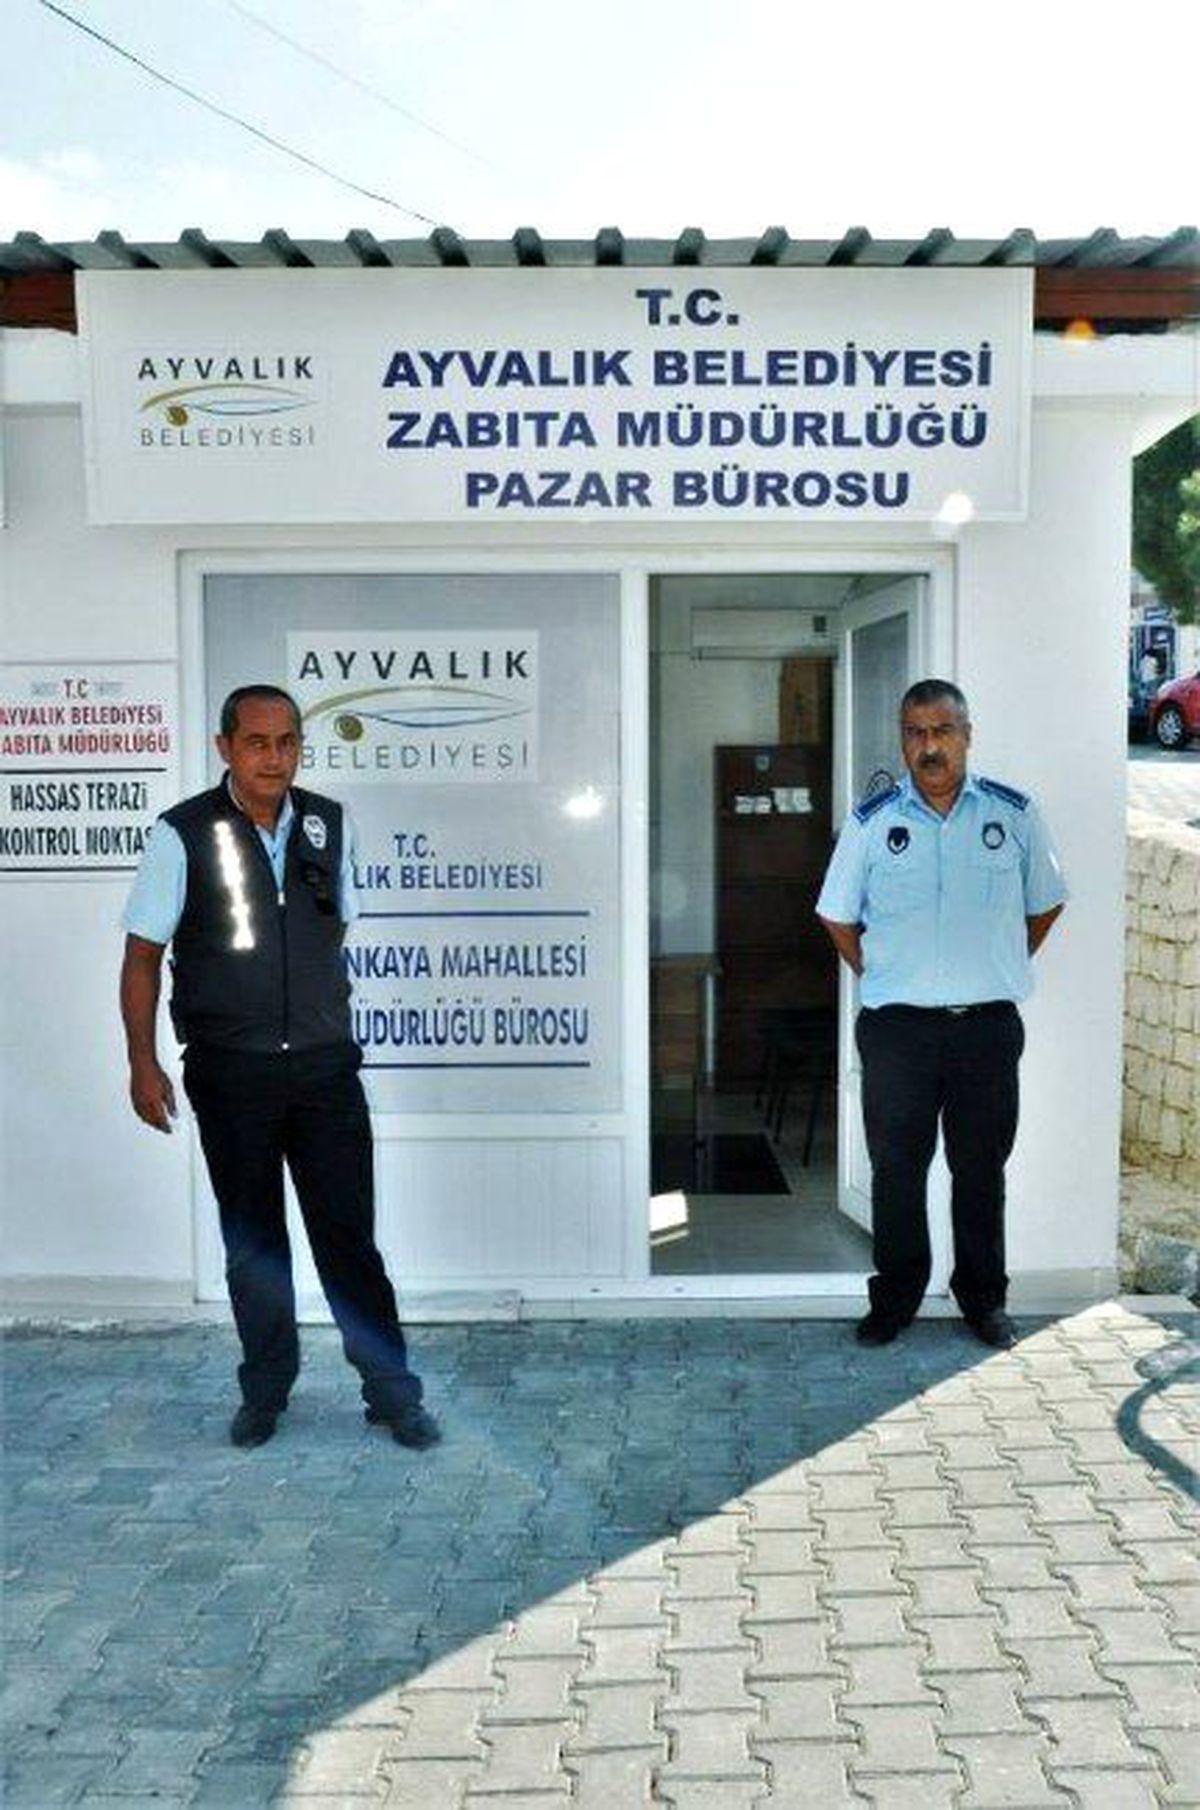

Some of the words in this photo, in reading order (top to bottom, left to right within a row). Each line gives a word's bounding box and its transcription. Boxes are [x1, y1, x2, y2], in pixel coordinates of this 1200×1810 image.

[635, 288, 739, 325] T.C.
[138, 356, 313, 380] AYVALIK
[381, 351, 632, 387] AYVALIK
[653, 342, 993, 387] BELEDİYESİ
[140, 425, 315, 447] BELEDİYESİ
[386, 411, 597, 448] ZABITA
[616, 403, 988, 448] MÜDÜRLÜĞÜ
[465, 471, 652, 507] PAZAR
[673, 463, 909, 507] BÜROSU
[299, 651, 529, 680] AYVALIK
[1, 734, 51, 755] ABITA
[10, 783, 80, 812] HASSAS
[0, 826, 80, 856] KONTROL
[394, 833, 436, 858] T.C.
[352, 864, 391, 889] LIK
[342, 946, 432, 978] NKAYA
[441, 935, 586, 978] MAHALLESİ
[355, 997, 487, 1046] ÜDÜRLÜĞÜ
[494, 997, 589, 1046] BÜROSU
